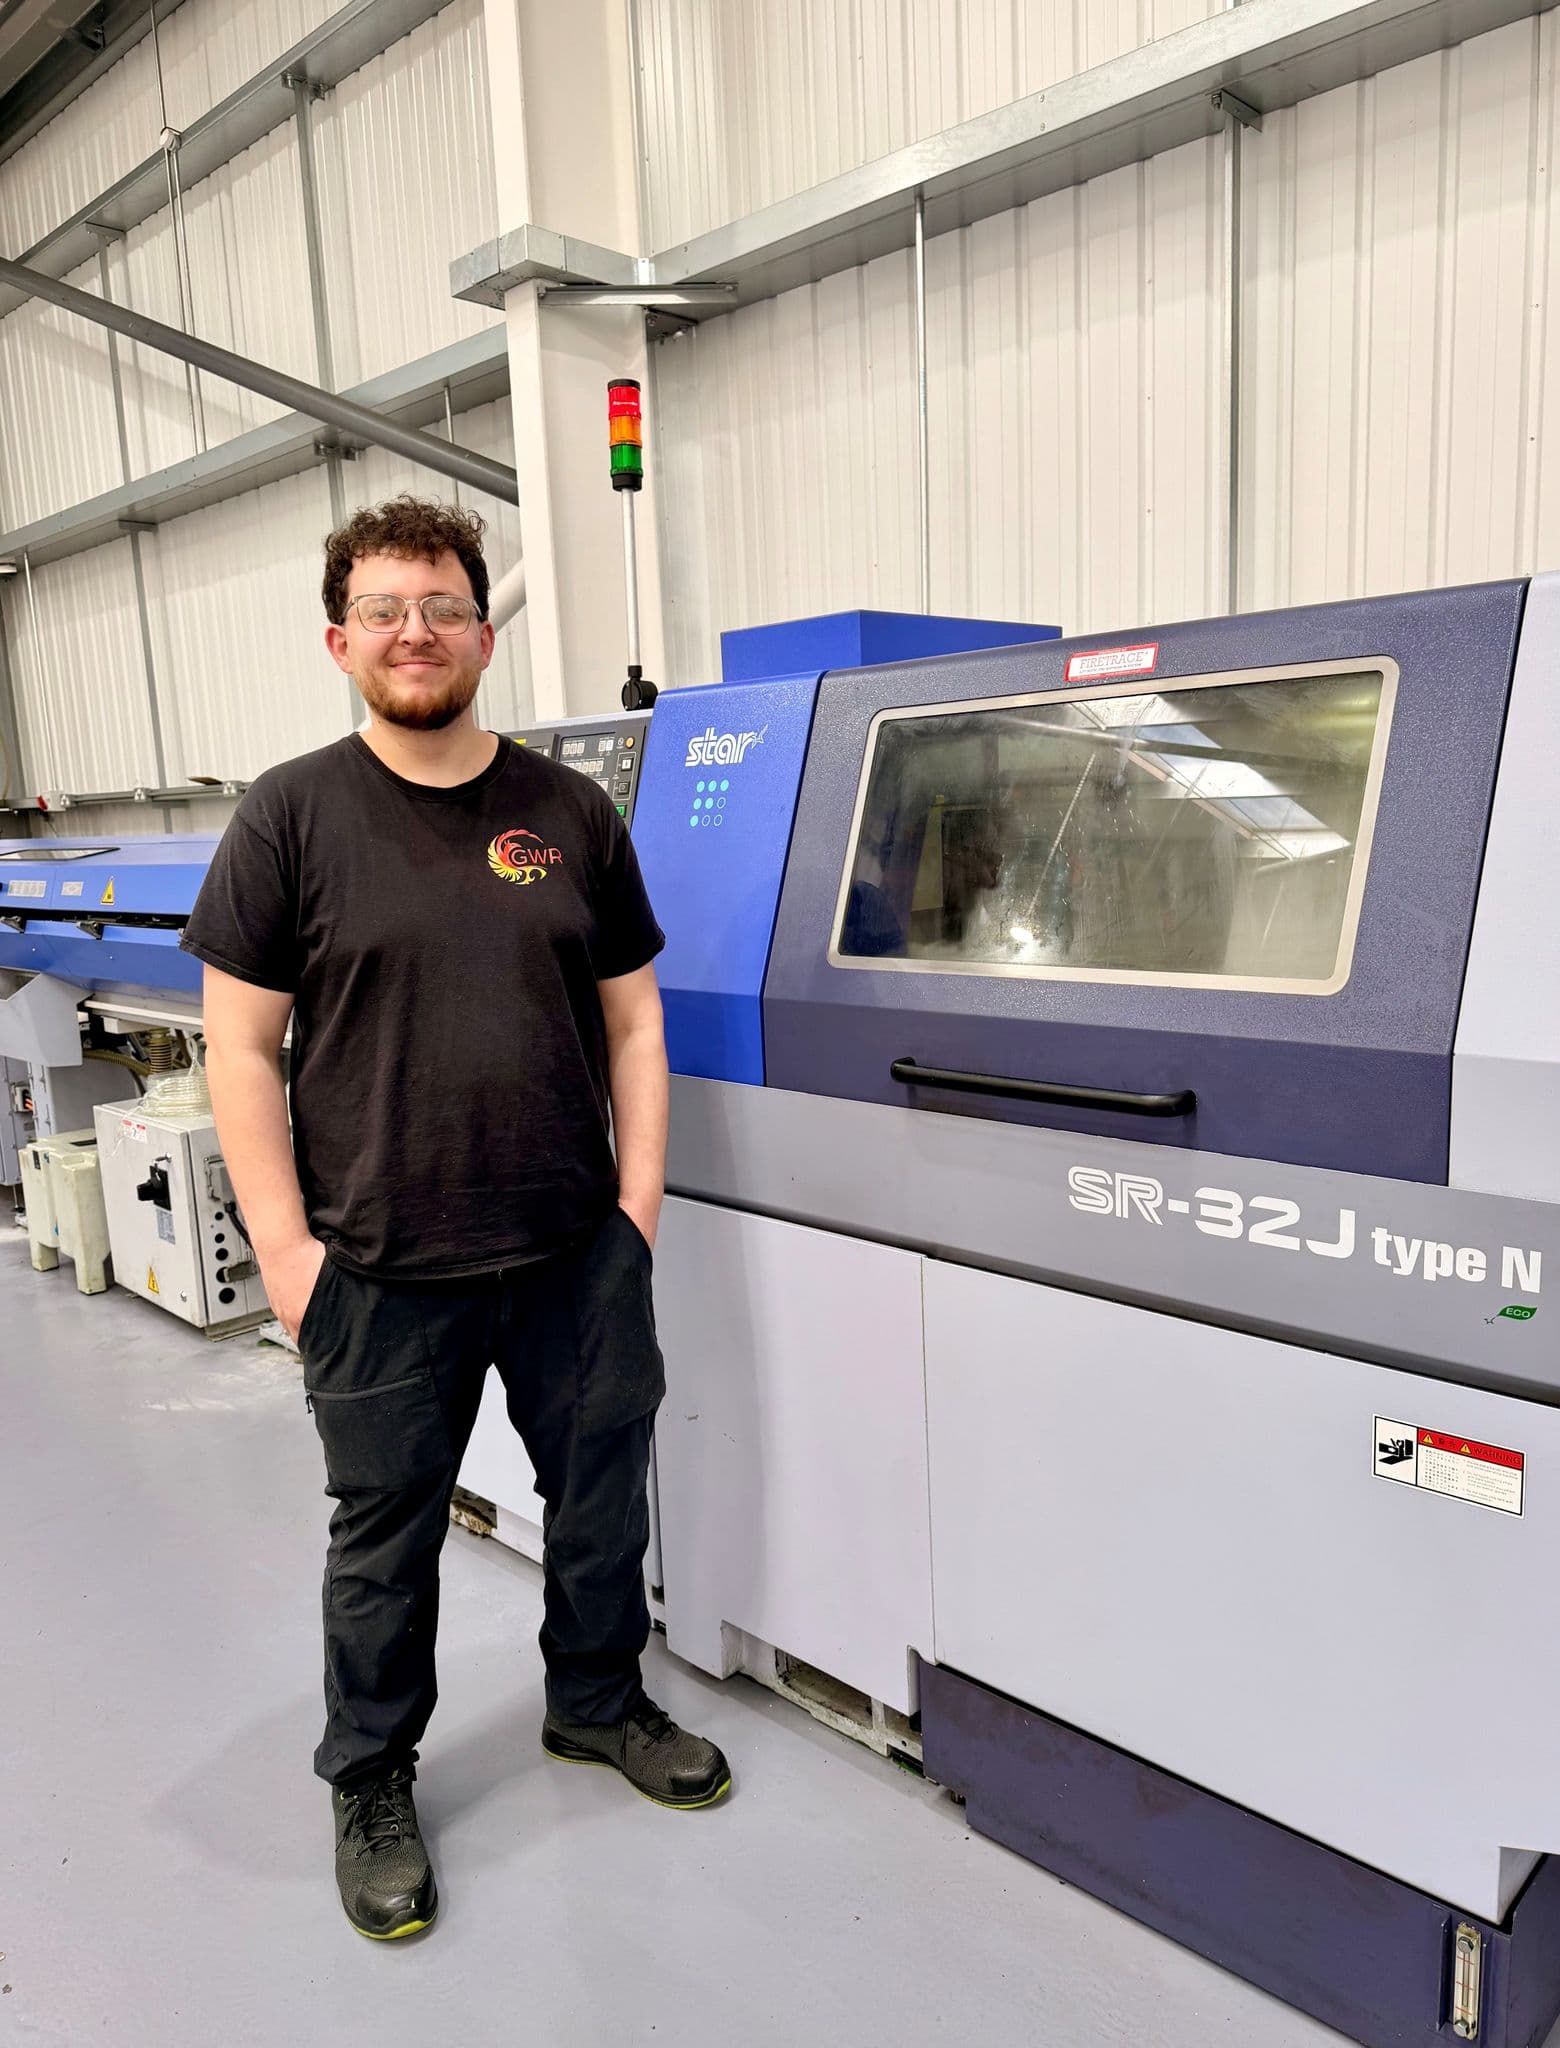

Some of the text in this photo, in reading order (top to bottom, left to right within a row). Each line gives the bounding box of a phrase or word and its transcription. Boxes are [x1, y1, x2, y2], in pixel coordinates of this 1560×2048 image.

[1079, 651, 1144, 669] FIRETRACE
[685, 726, 759, 767] star
[511, 847, 563, 865] GWR
[1068, 1165, 1542, 1294] SR-32J type N
[1505, 1307, 1532, 1319] ECO
[1473, 1447, 1521, 1465] WARNING
